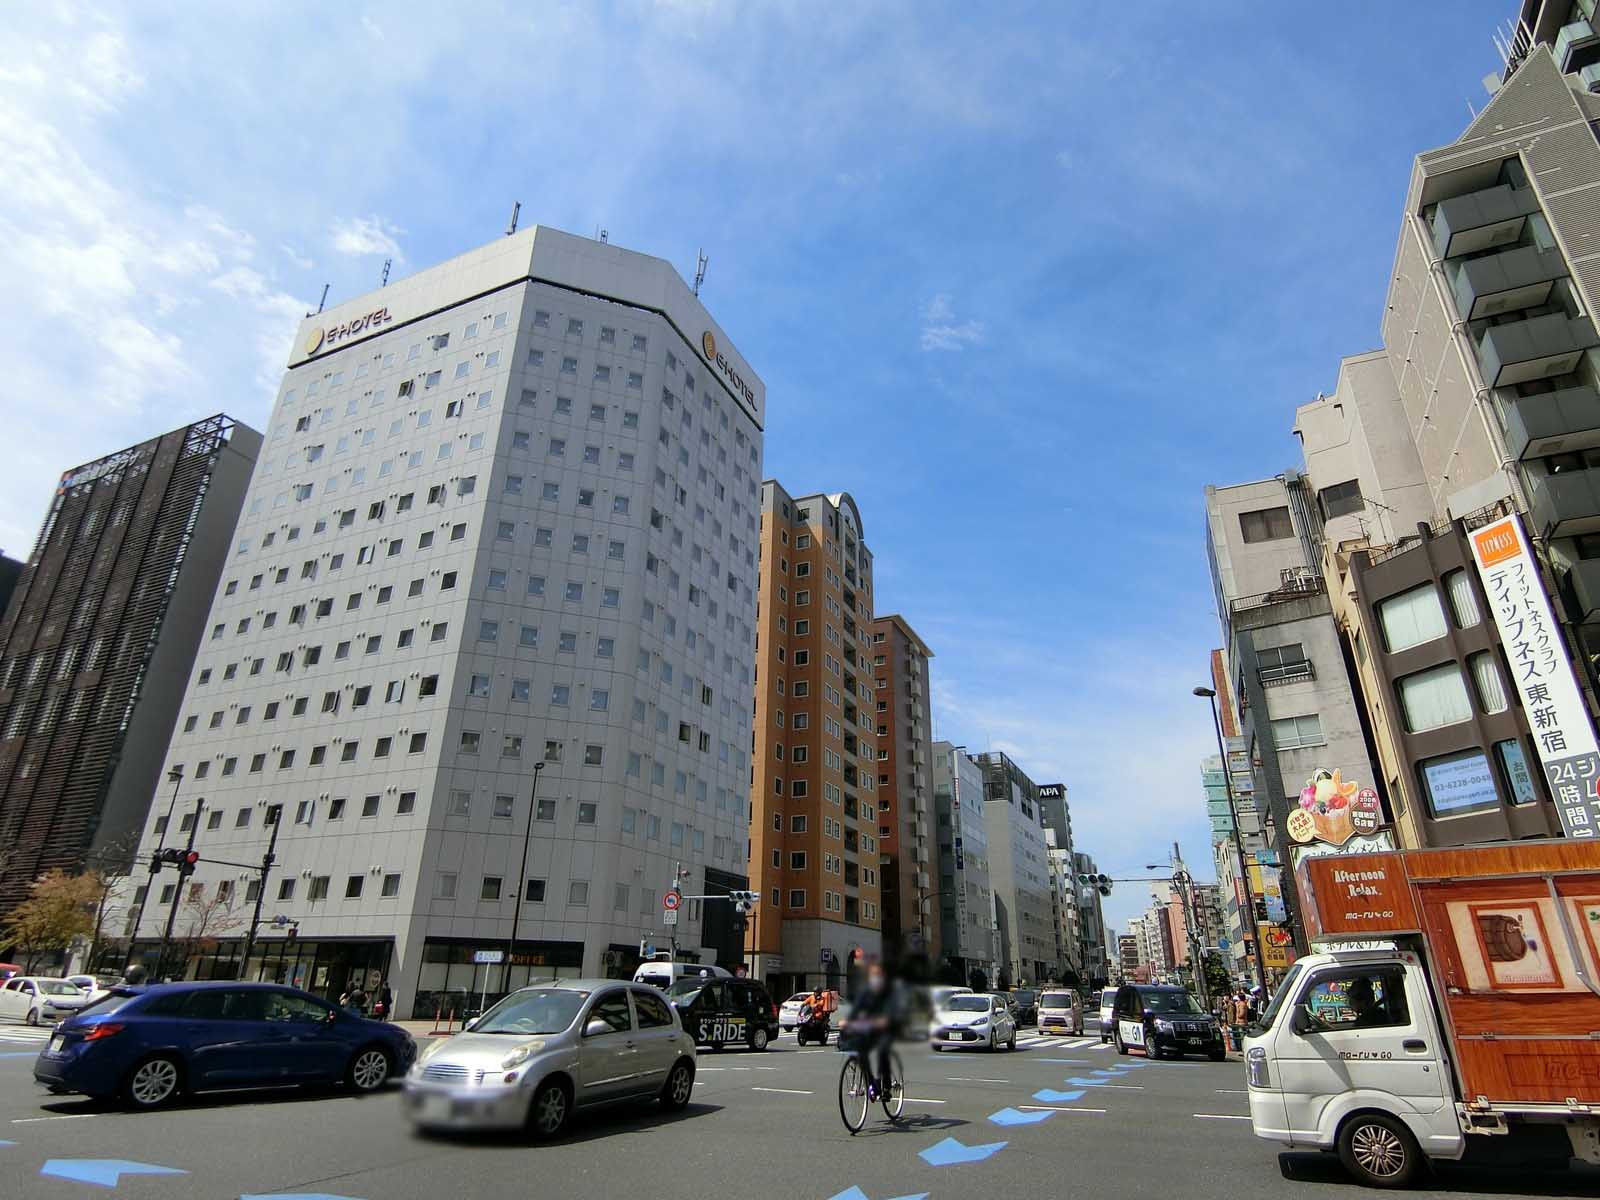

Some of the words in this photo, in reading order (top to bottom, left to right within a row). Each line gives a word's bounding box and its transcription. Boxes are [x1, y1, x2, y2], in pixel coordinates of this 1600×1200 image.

[1510, 562, 1558, 675] フィットネスクラブ
[1039, 787, 1060, 797] APA
[1334, 870, 1385, 883] Afternoon
[1348, 883, 1378, 897] Relax
